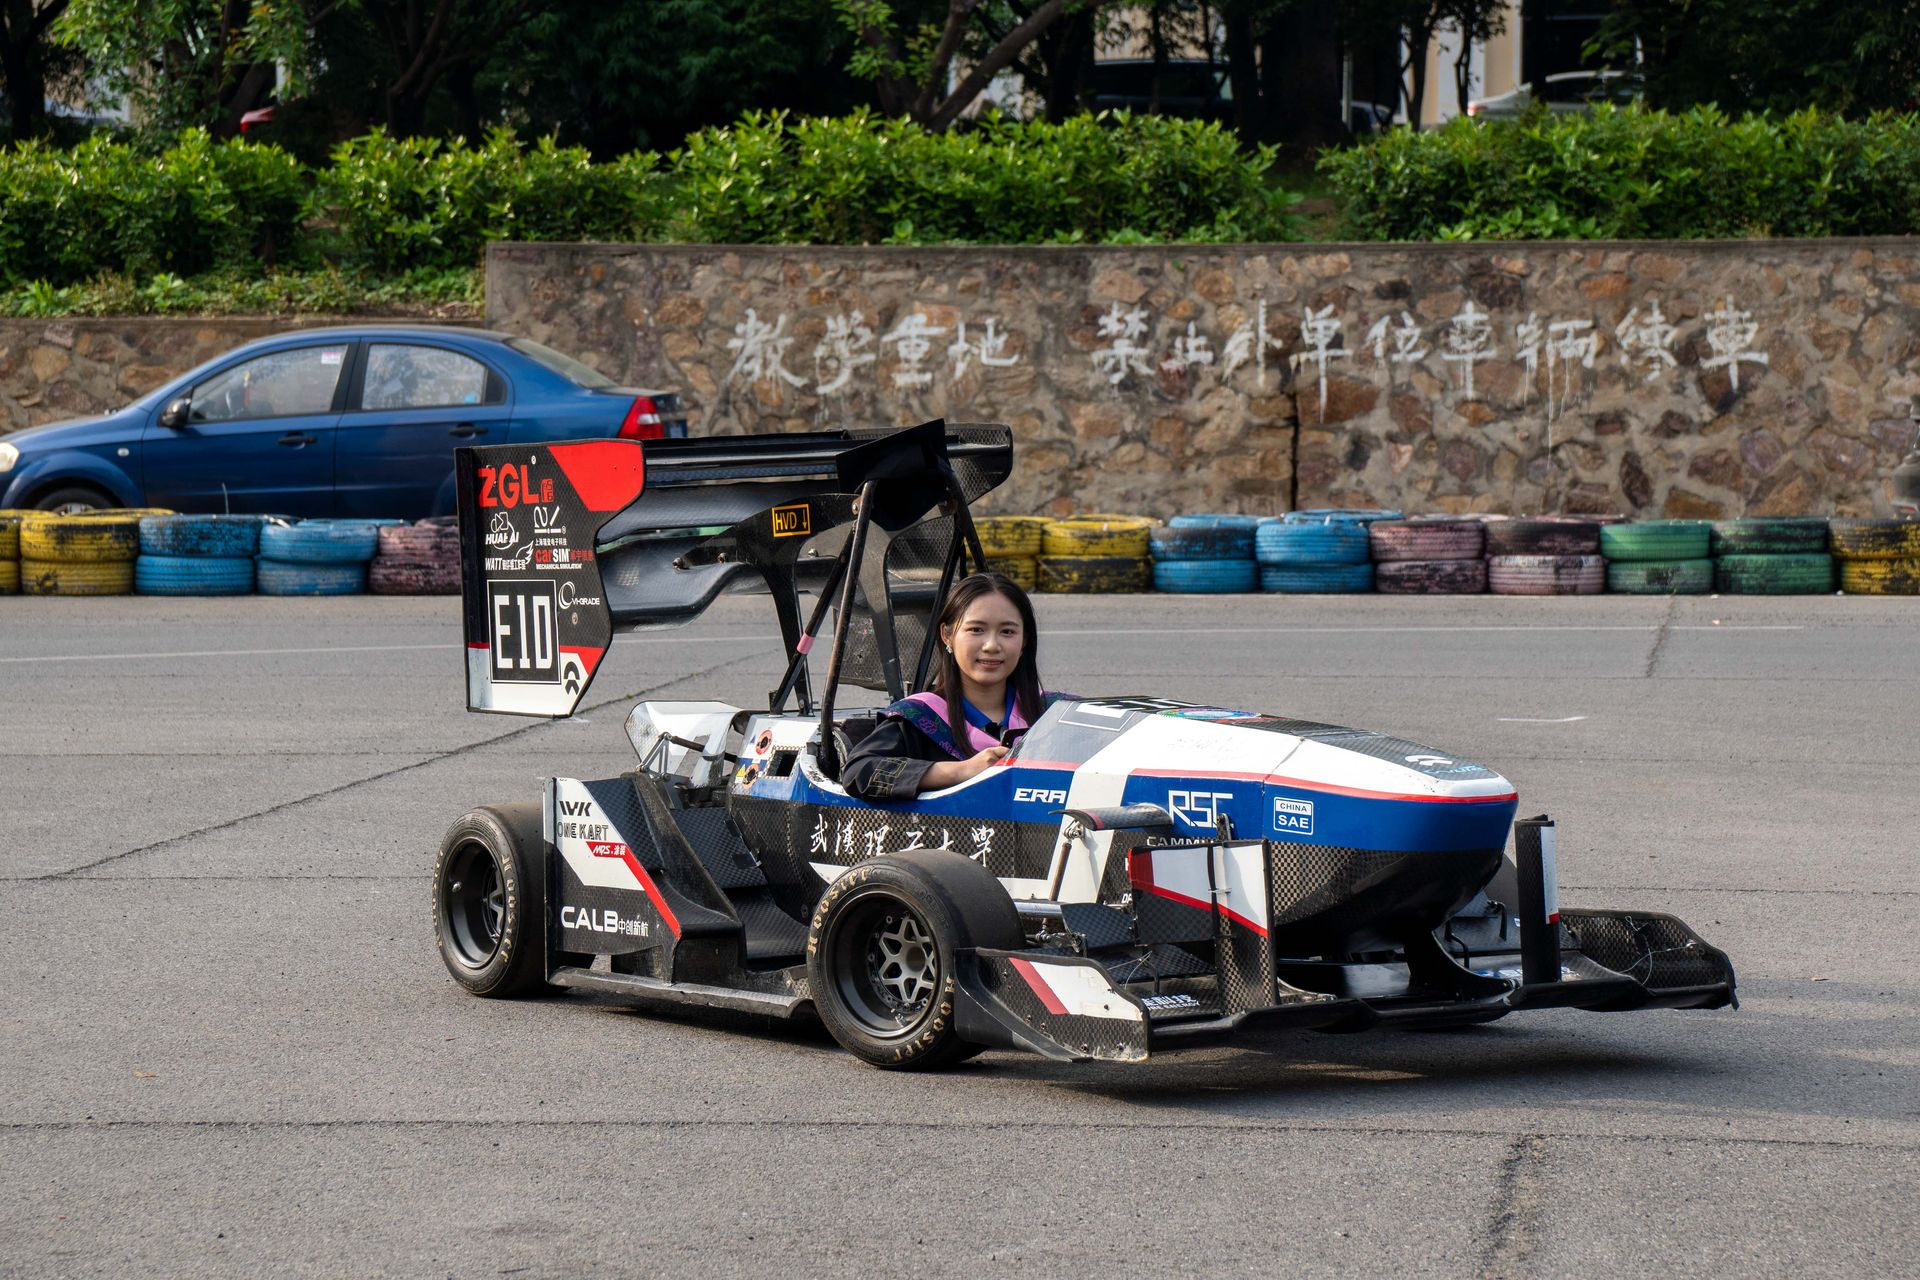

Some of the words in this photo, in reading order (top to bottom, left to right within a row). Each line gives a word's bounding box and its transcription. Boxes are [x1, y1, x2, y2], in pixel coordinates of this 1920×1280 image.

[478, 463, 539, 508] ZGL
[775, 511, 797, 530] HVD
[485, 558, 502, 571] WATT
[1013, 787, 1067, 804] ERA
[1280, 802, 1307, 812] CHINA
[1278, 814, 1309, 829] SAE
[557, 821, 577, 838] ONE
[579, 823, 609, 841] KART
[561, 905, 619, 933] CALB
